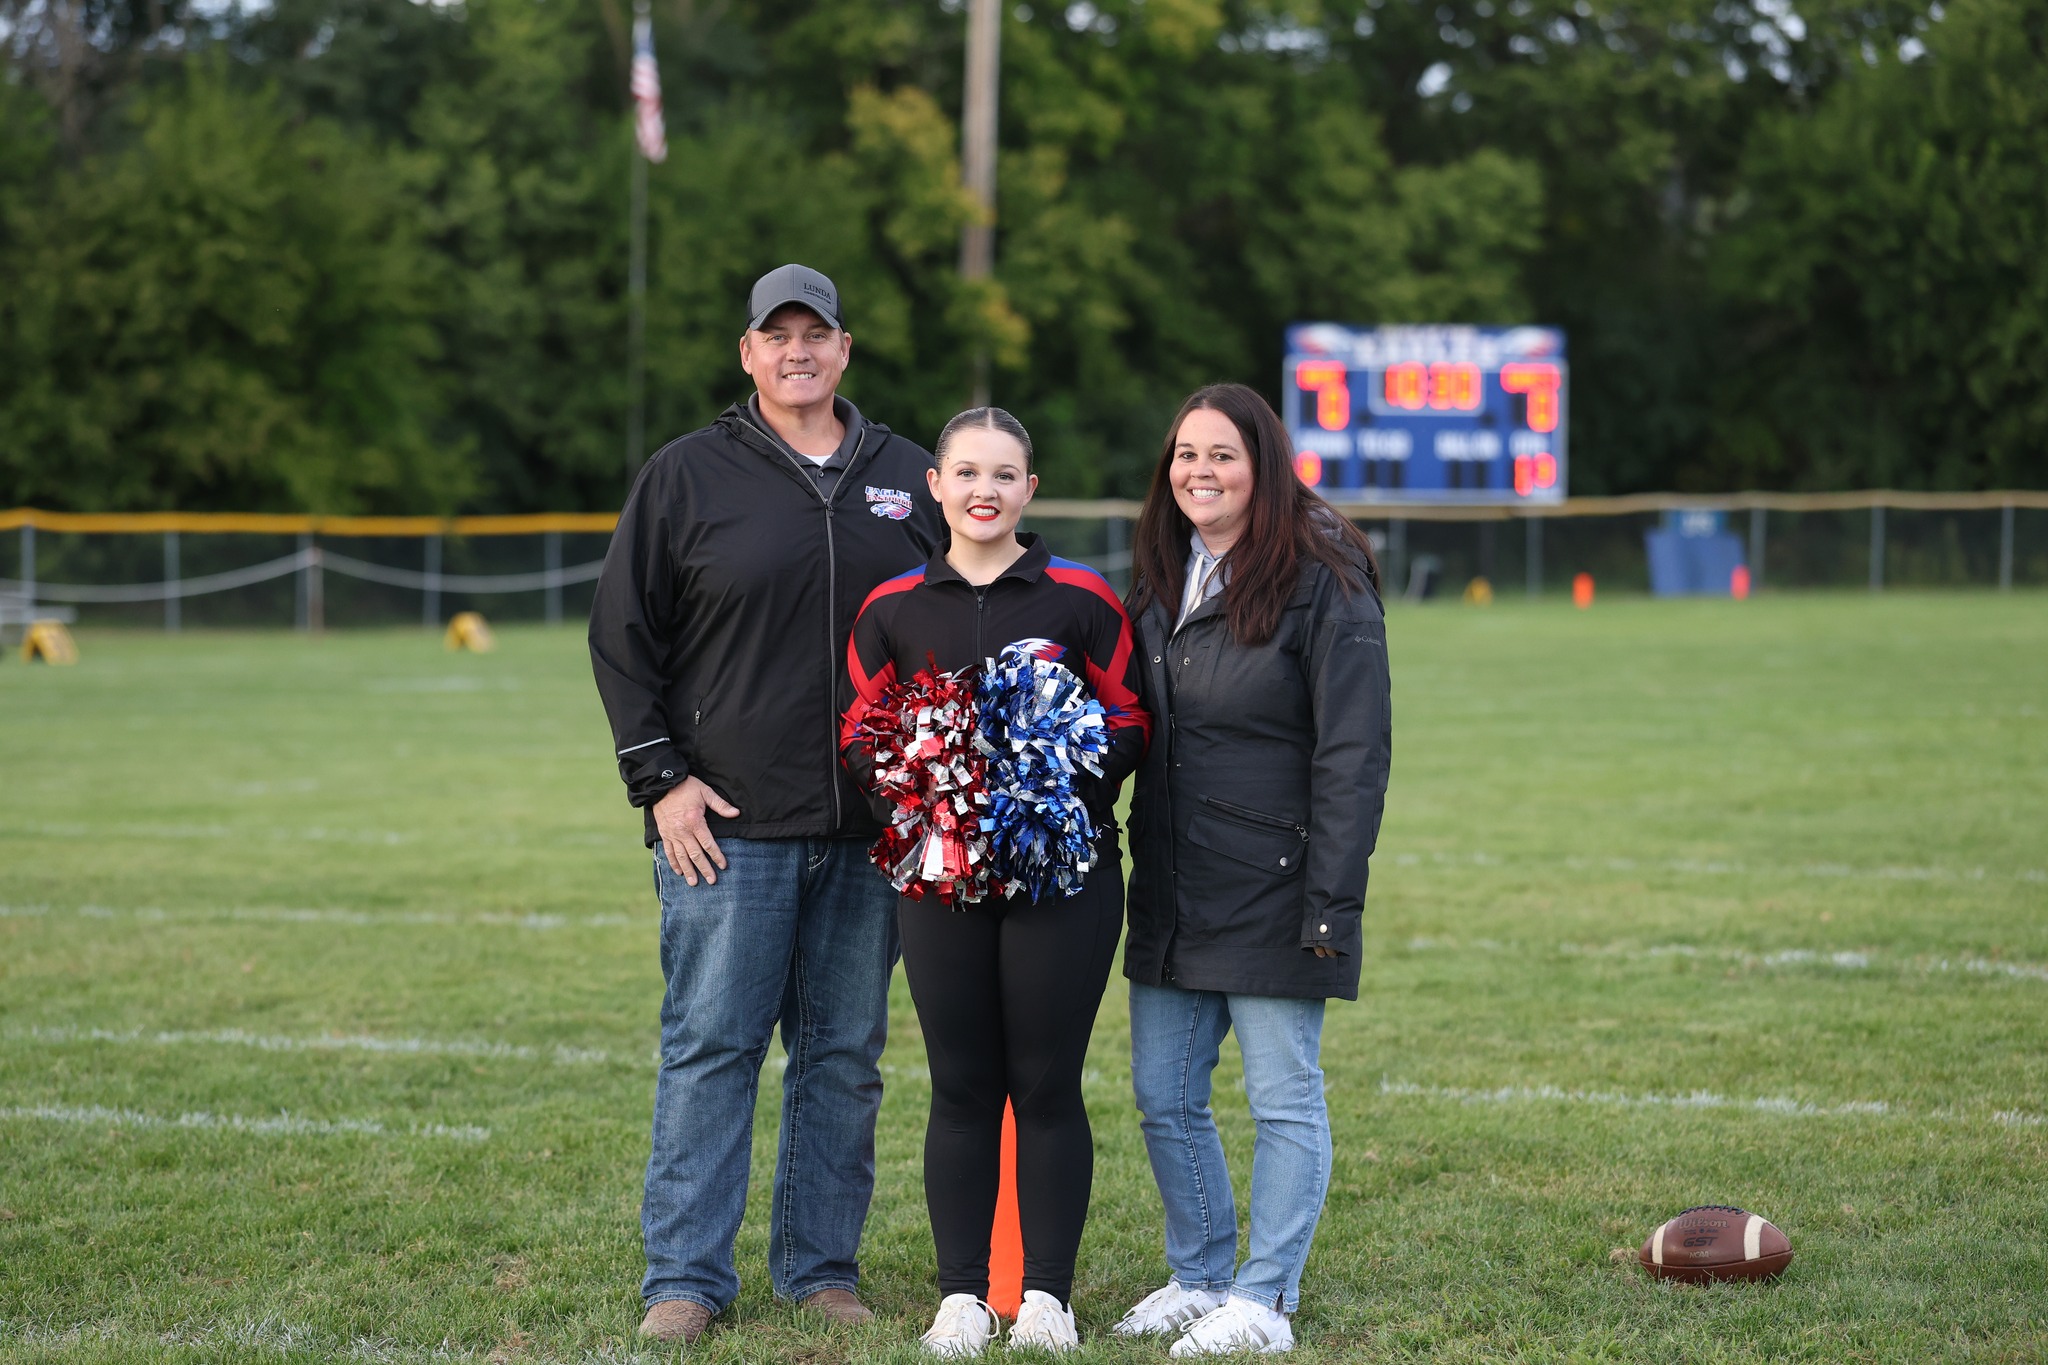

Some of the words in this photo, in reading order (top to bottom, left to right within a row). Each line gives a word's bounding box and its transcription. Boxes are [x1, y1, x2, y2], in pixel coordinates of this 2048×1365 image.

[803, 282, 832, 300] LUNDA
[865, 485, 911, 501] EAGLES
[1679, 1217, 1729, 1229] Wilson
[1683, 1236, 1718, 1247] GST
